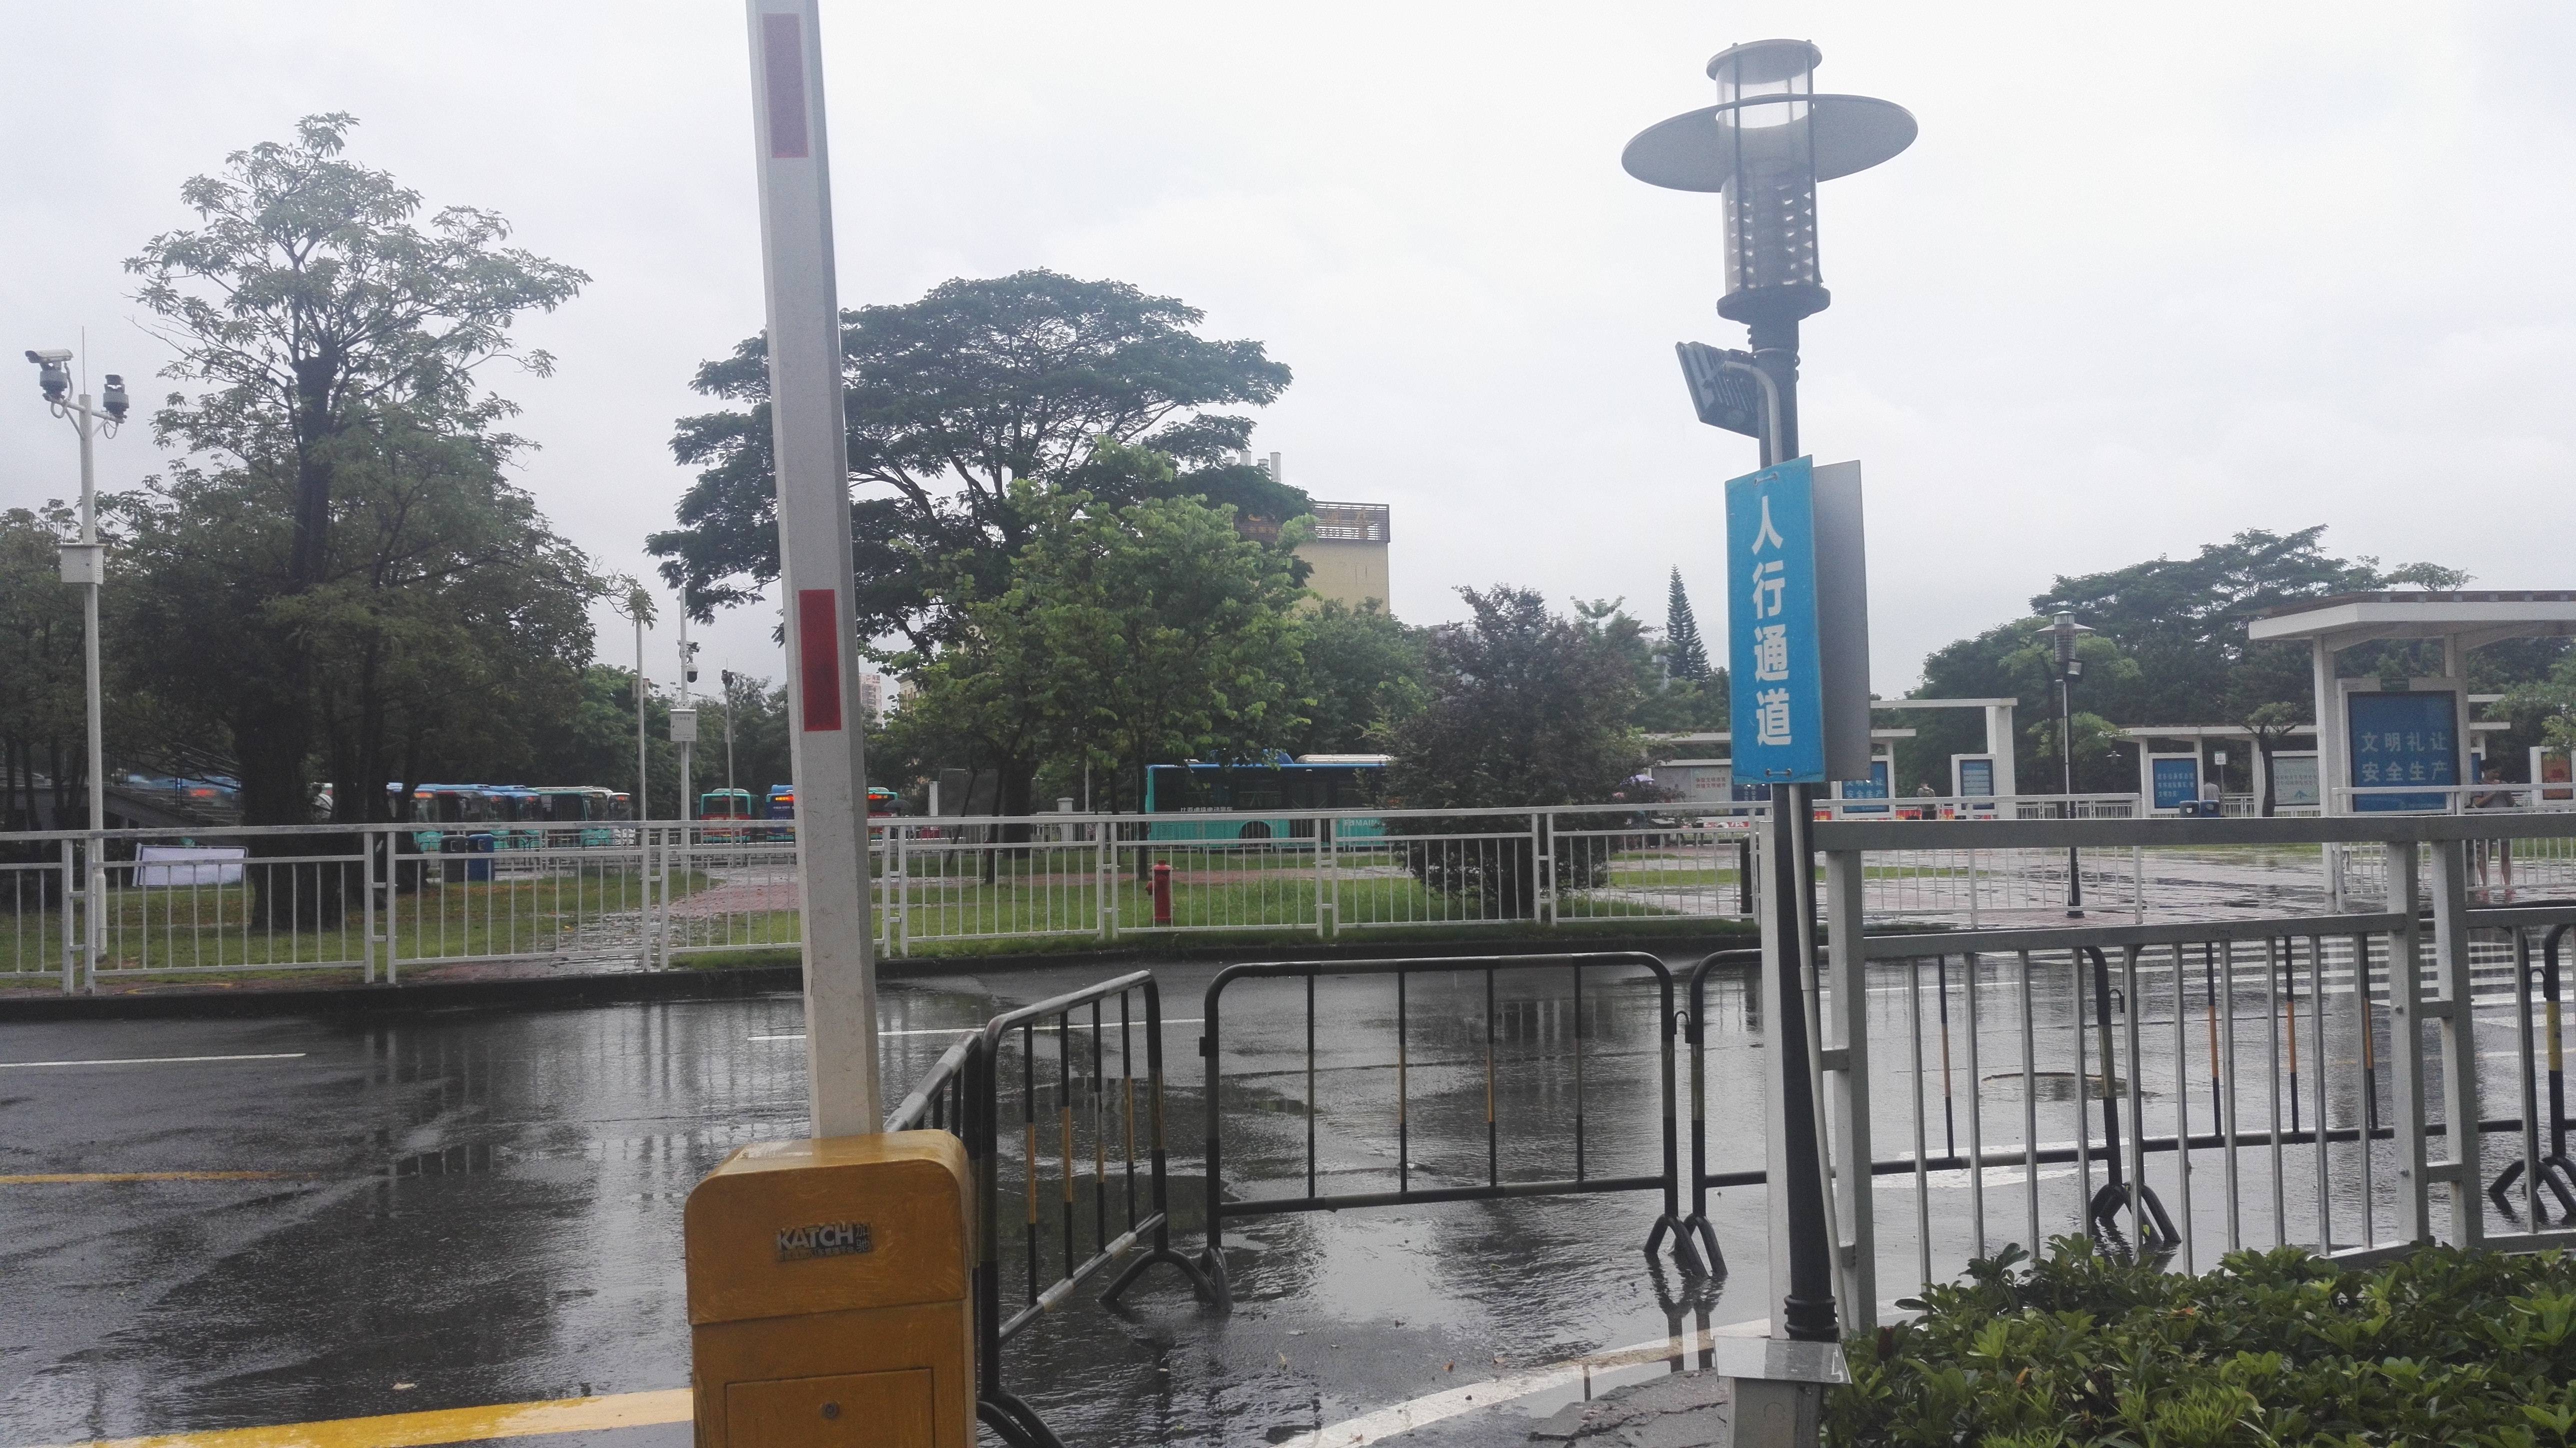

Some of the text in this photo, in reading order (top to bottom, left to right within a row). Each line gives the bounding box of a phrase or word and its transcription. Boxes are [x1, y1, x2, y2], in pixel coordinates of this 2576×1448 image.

[1752, 496, 1792, 746] 人行通道
[2361, 732, 2448, 752] 文明礼让
[2362, 760, 2448, 782] 安全生产
[1846, 790, 1884, 798] 安全生产
[776, 1224, 854, 1250] KATCH
